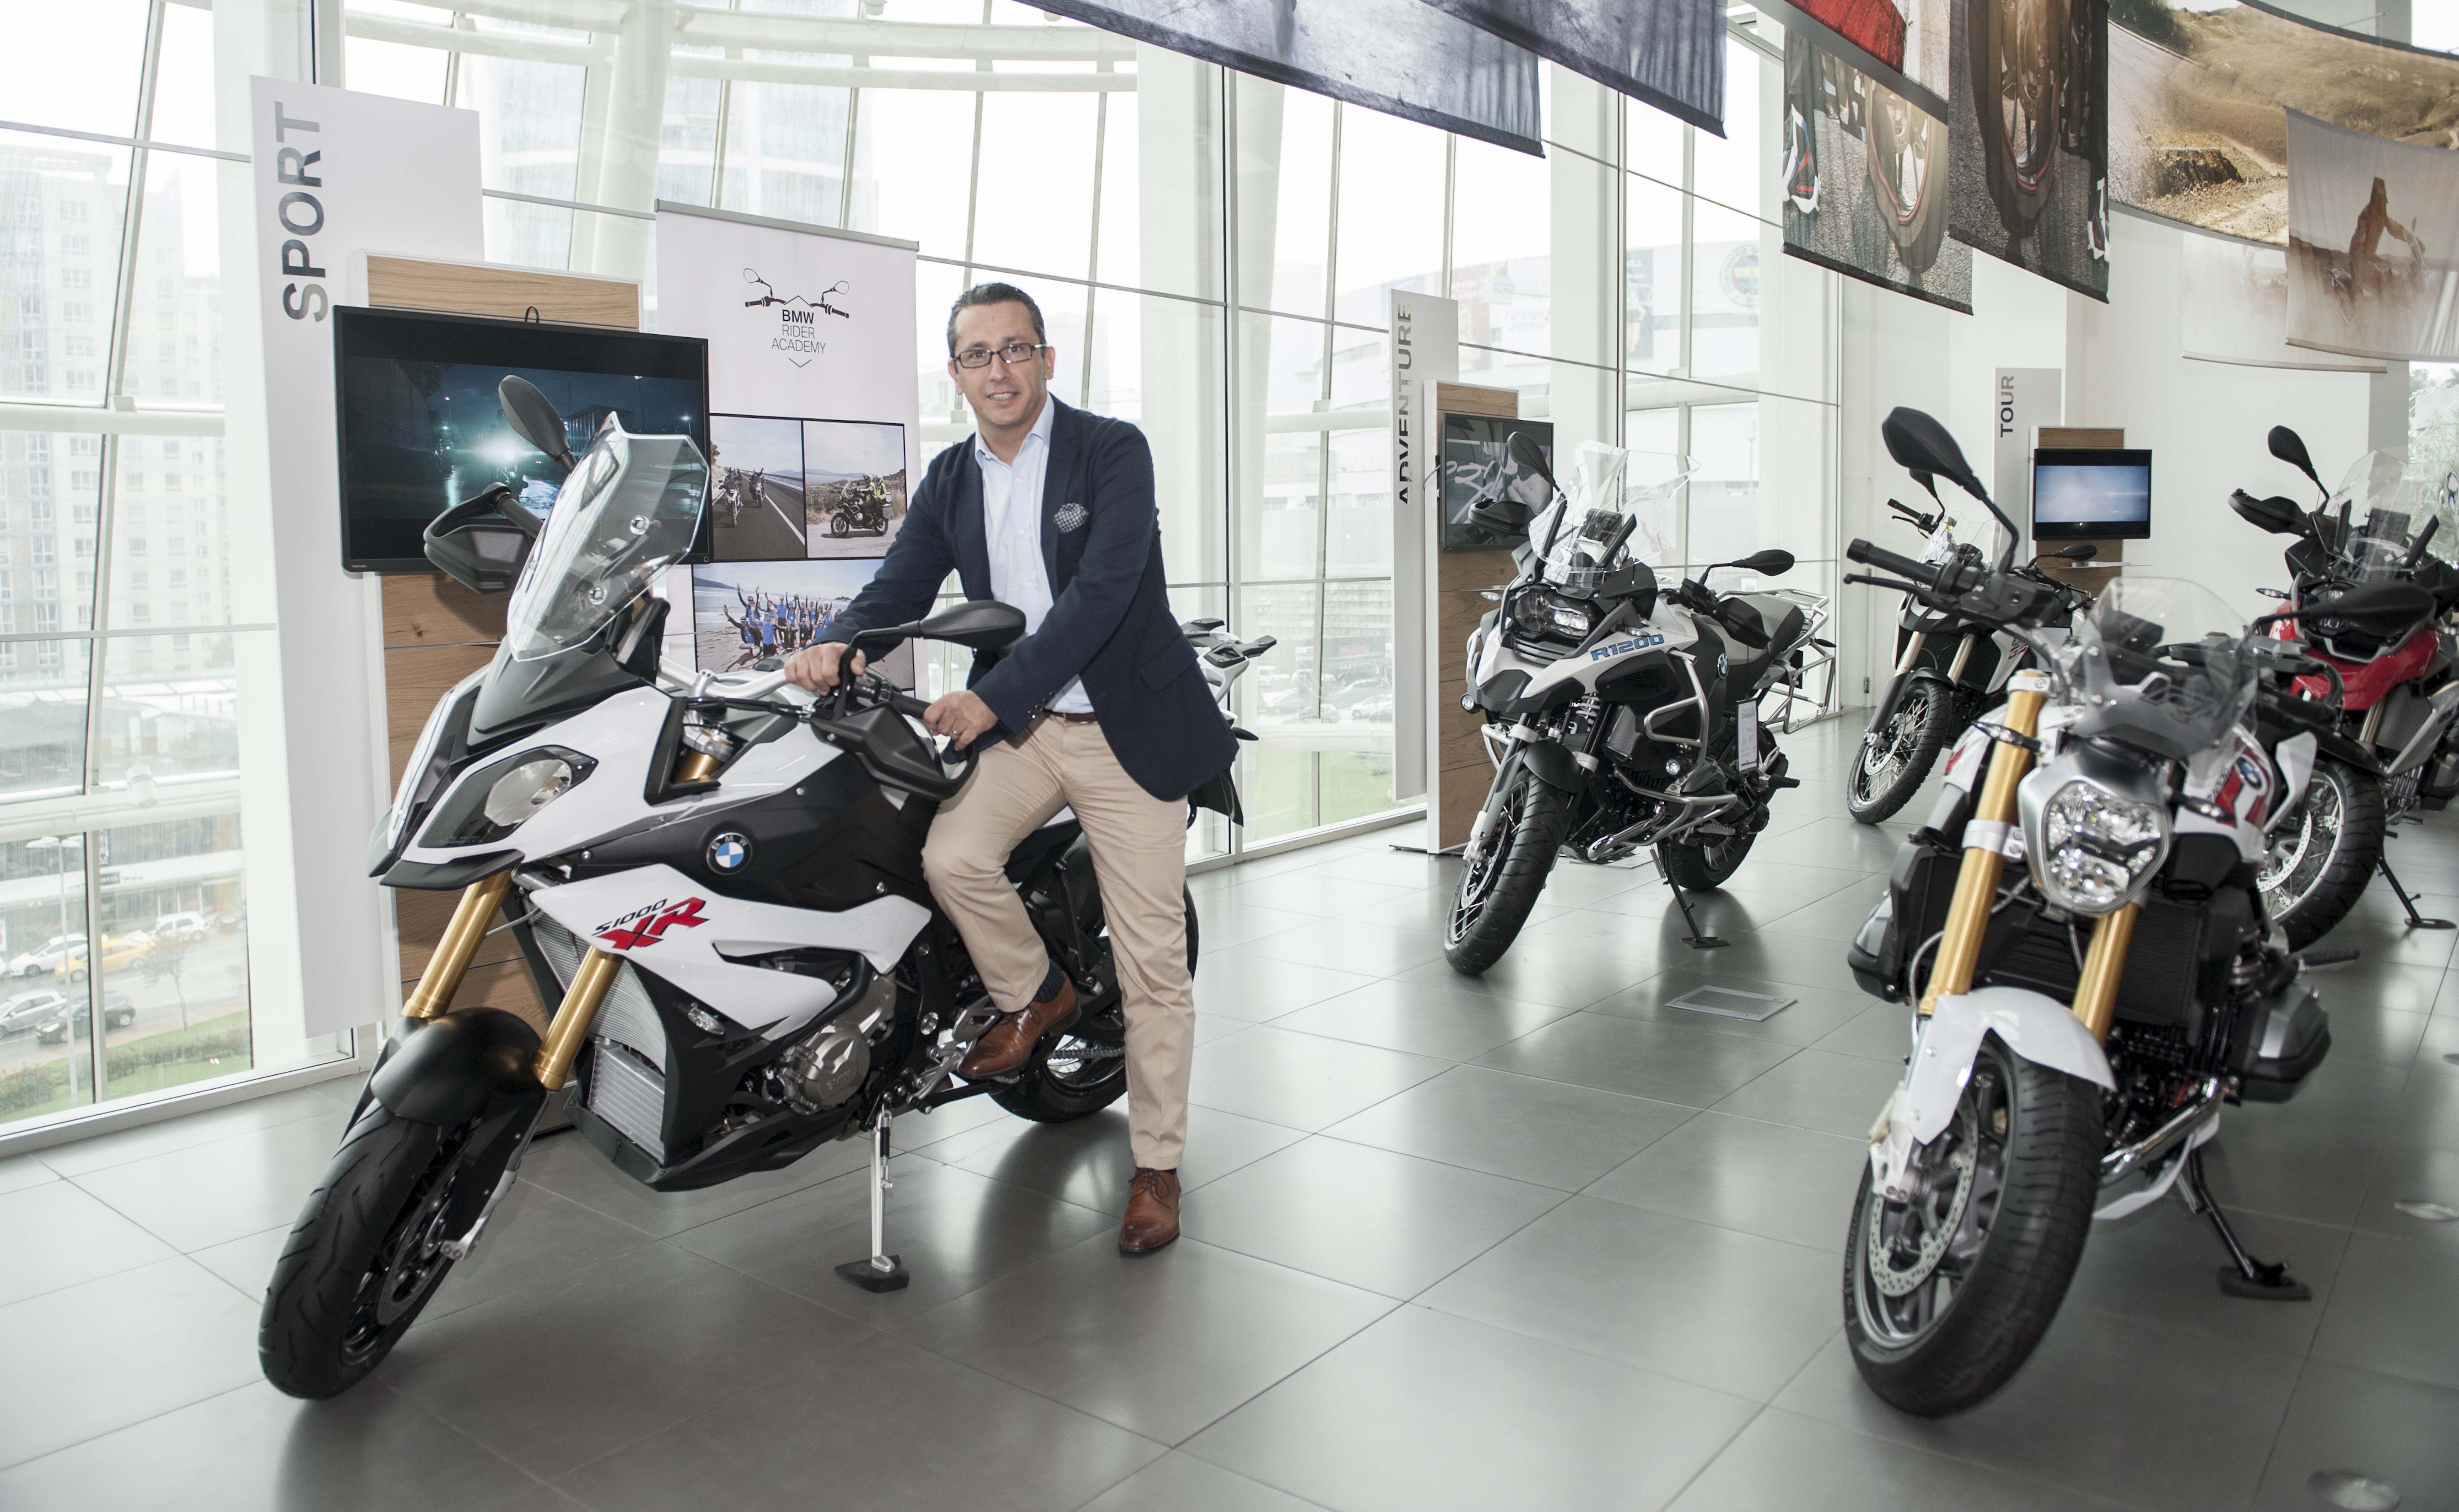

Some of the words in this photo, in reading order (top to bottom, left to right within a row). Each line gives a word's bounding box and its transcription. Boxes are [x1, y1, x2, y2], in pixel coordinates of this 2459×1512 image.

[274, 101, 328, 323] SPORT
[782, 309, 814, 324] BMW
[782, 325, 815, 339] RIDER
[771, 338, 826, 353] ACADEMY
[1397, 302, 1412, 507] ADVENTURE
[2000, 375, 2015, 438] TOUR
[1591, 634, 1664, 661] R1200
[711, 835, 748, 850] BMW
[591, 898, 668, 936] S1000
[595, 897, 710, 951] XR
